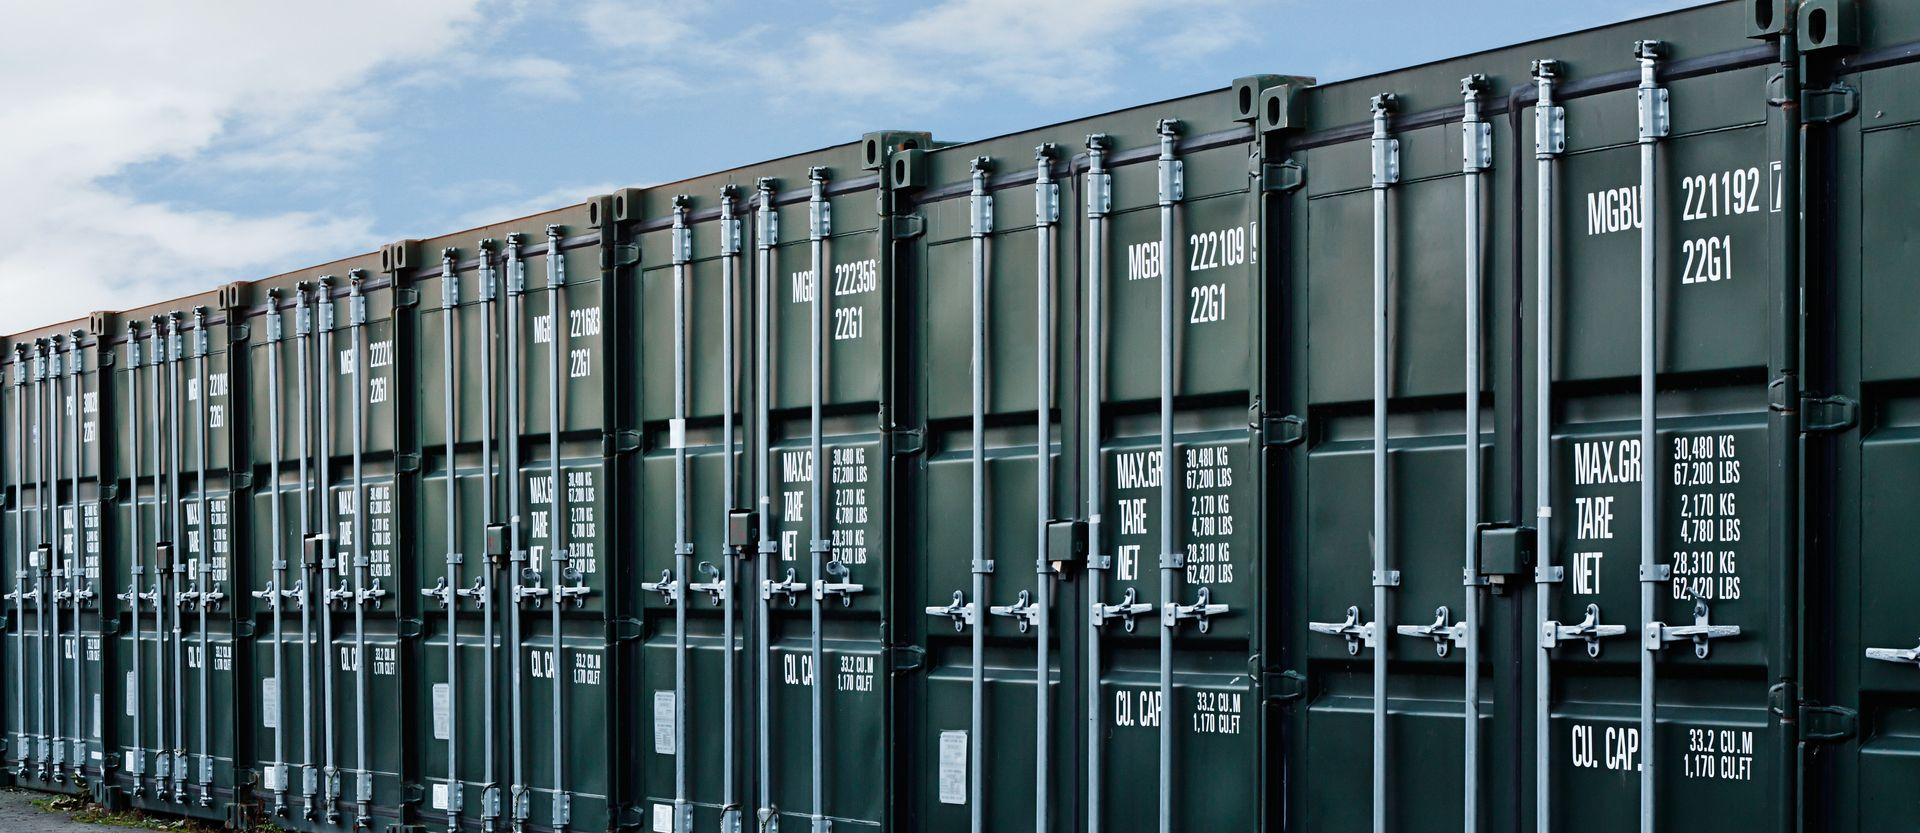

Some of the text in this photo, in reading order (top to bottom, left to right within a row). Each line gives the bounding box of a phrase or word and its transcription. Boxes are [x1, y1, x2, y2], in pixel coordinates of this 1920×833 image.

[1682, 167, 1760, 221] 221192
[1190, 226, 1244, 271] 222109
[1682, 235, 1731, 285] 22G1
[835, 259, 876, 296] 222356
[1190, 283, 1225, 323] 22G1
[570, 306, 600, 337] 221683
[835, 306, 862, 340] 22G1
[570, 348, 590, 377] 22G1
[855, 447, 865, 464] KG
[1186, 446, 1228, 468] 30,480 KG
[1674, 435, 1735, 461] 30,480 KG
[832, 465, 868, 484] 67,200 LBS
[1574, 439, 1642, 485] MAX.GR
[1674, 461, 1740, 486] 67,200 LBS
[1186, 468, 1232, 490] 67,200 LBS
[784, 490, 803, 521] TARE
[836, 488, 865, 507] 2,170 KG
[1191, 494, 1229, 516] 2,170 KG
[1681, 493, 1735, 518] 2,170 KG
[531, 511, 548, 538] TARE
[836, 507, 868, 525] 4,780 LBS
[1118, 498, 1147, 535] TARE
[1191, 516, 1232, 537] 4,780 LBS
[1576, 496, 1613, 539] TARE
[832, 529, 865, 547] 28,310 KG
[1681, 519, 1740, 544] 4,780 LBS
[782, 530, 797, 561] NET
[855, 547, 867, 564] LBS
[1187, 543, 1229, 563] 28,310 KG
[1117, 544, 1140, 580] NET
[1187, 564, 1233, 585] 62,420 LBS
[1573, 552, 1603, 594] NET
[1673, 551, 1735, 576] 28,310 KG
[1673, 577, 1740, 601] 62,420 LBS
[531, 650, 543, 677] CU.
[784, 653, 798, 684] CU.
[840, 656, 854, 673] 33.2
[838, 674, 853, 691] 1,170
[1115, 690, 1134, 726] CU.
[1197, 692, 1240, 712] 33.2 CU.M
[1193, 713, 1240, 734] 1,170 CU.FT
[1571, 724, 1598, 768] CU.
[1689, 729, 1753, 754] 33.2 CU.M
[1684, 753, 1752, 780] 1,170 CU.FT
